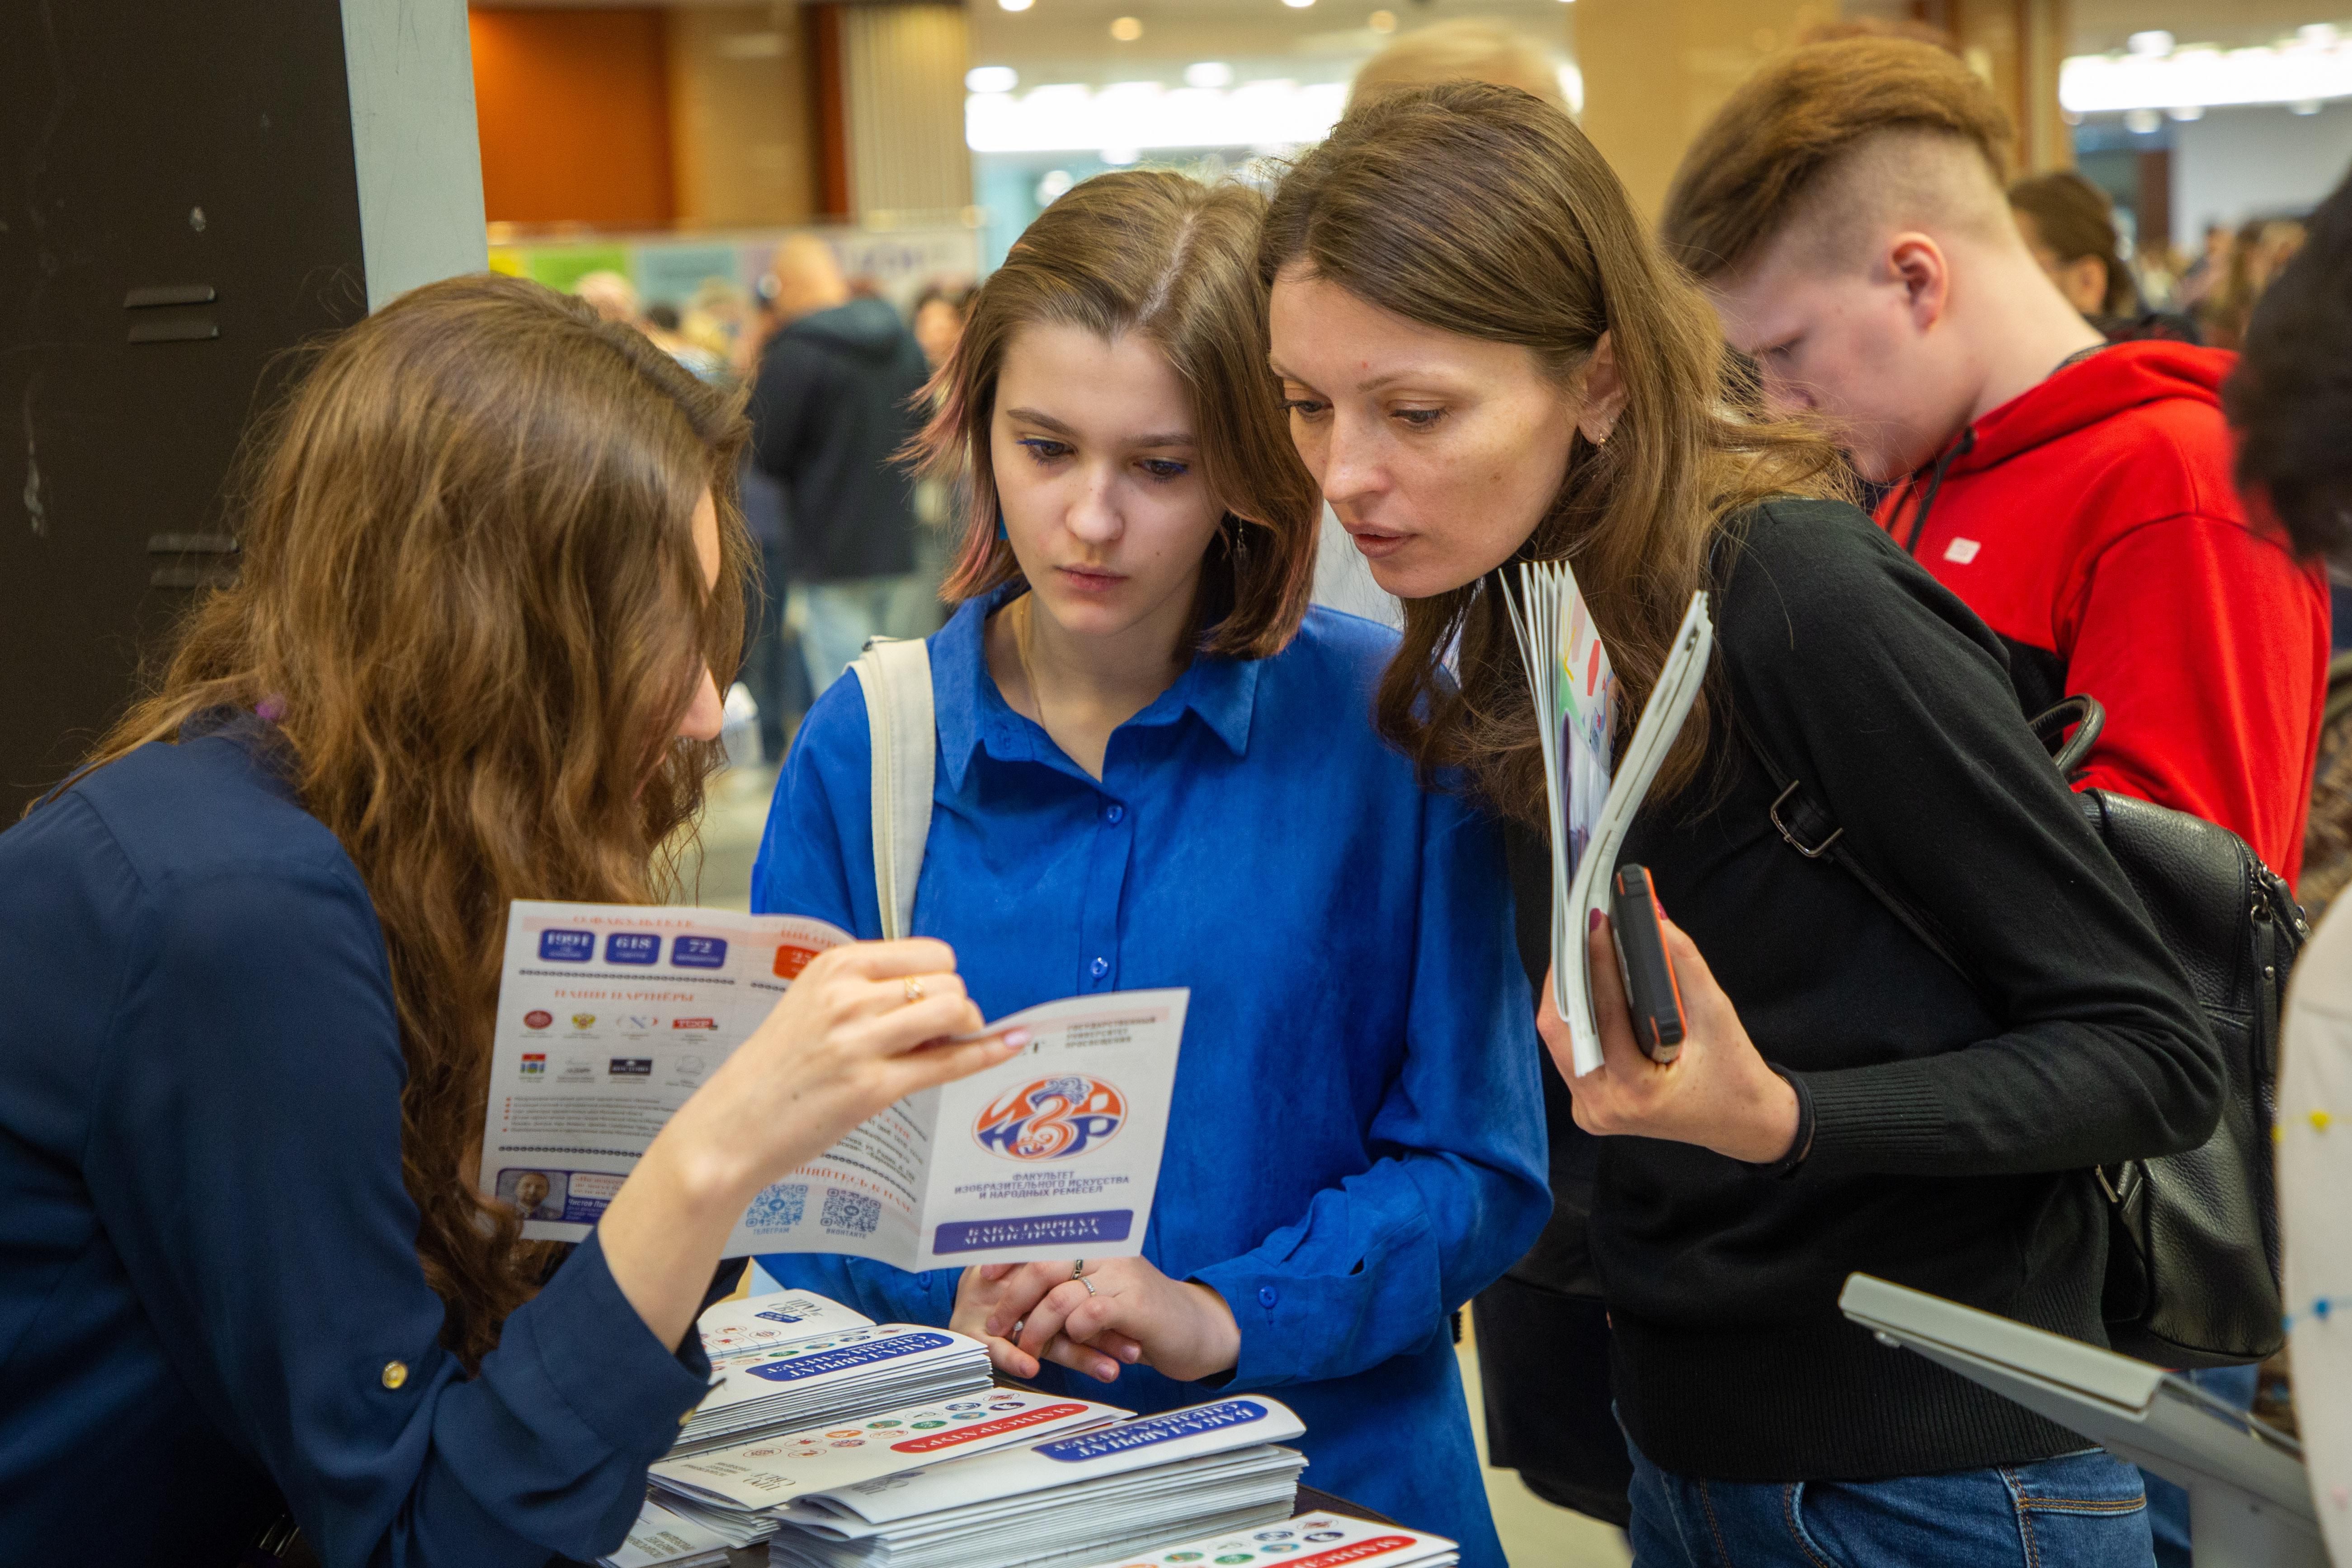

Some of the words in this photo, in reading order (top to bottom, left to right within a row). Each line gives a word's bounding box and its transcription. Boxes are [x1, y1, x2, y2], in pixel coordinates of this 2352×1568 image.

[547, 932, 589, 946] 1991
[615, 936, 651, 948] 618
[689, 939, 712, 953] 72
[554, 989, 607, 999] НАШИ
[1012, 1170, 1075, 1181] ФАКУЛЬТЕТ
[955, 1181, 1065, 1195] ИЗОБРАЗИТЕЛЬНОГО
[1068, 1176, 1129, 1187] ИСКУССТВА
[990, 1189, 1050, 1199] НАРОДНЫХ
[1053, 1185, 1103, 1196] РЕМЕСЕЛ
[753, 1227, 790, 1235] ТЕЛЕГРАМ
[826, 1228, 867, 1239] ВКОНТАКТЕ
[968, 1218, 1099, 1237] БАКАЛАВРИАТ
[965, 1227, 1099, 1245] МАГИСТРАТУРА
[767, 1335, 927, 1374] СПЕЦИАЛИТЕТ
[791, 1339, 943, 1377] БАКАЛАВРИАТ
[910, 1407, 1075, 1450] МАГИСТРАТУРА
[1054, 1402, 1240, 1452] СПЕЦИАЛИТЕТ
[1079, 1408, 1255, 1458] БАКАЛАВРИАТ
[743, 1479, 781, 1491] ПРО
